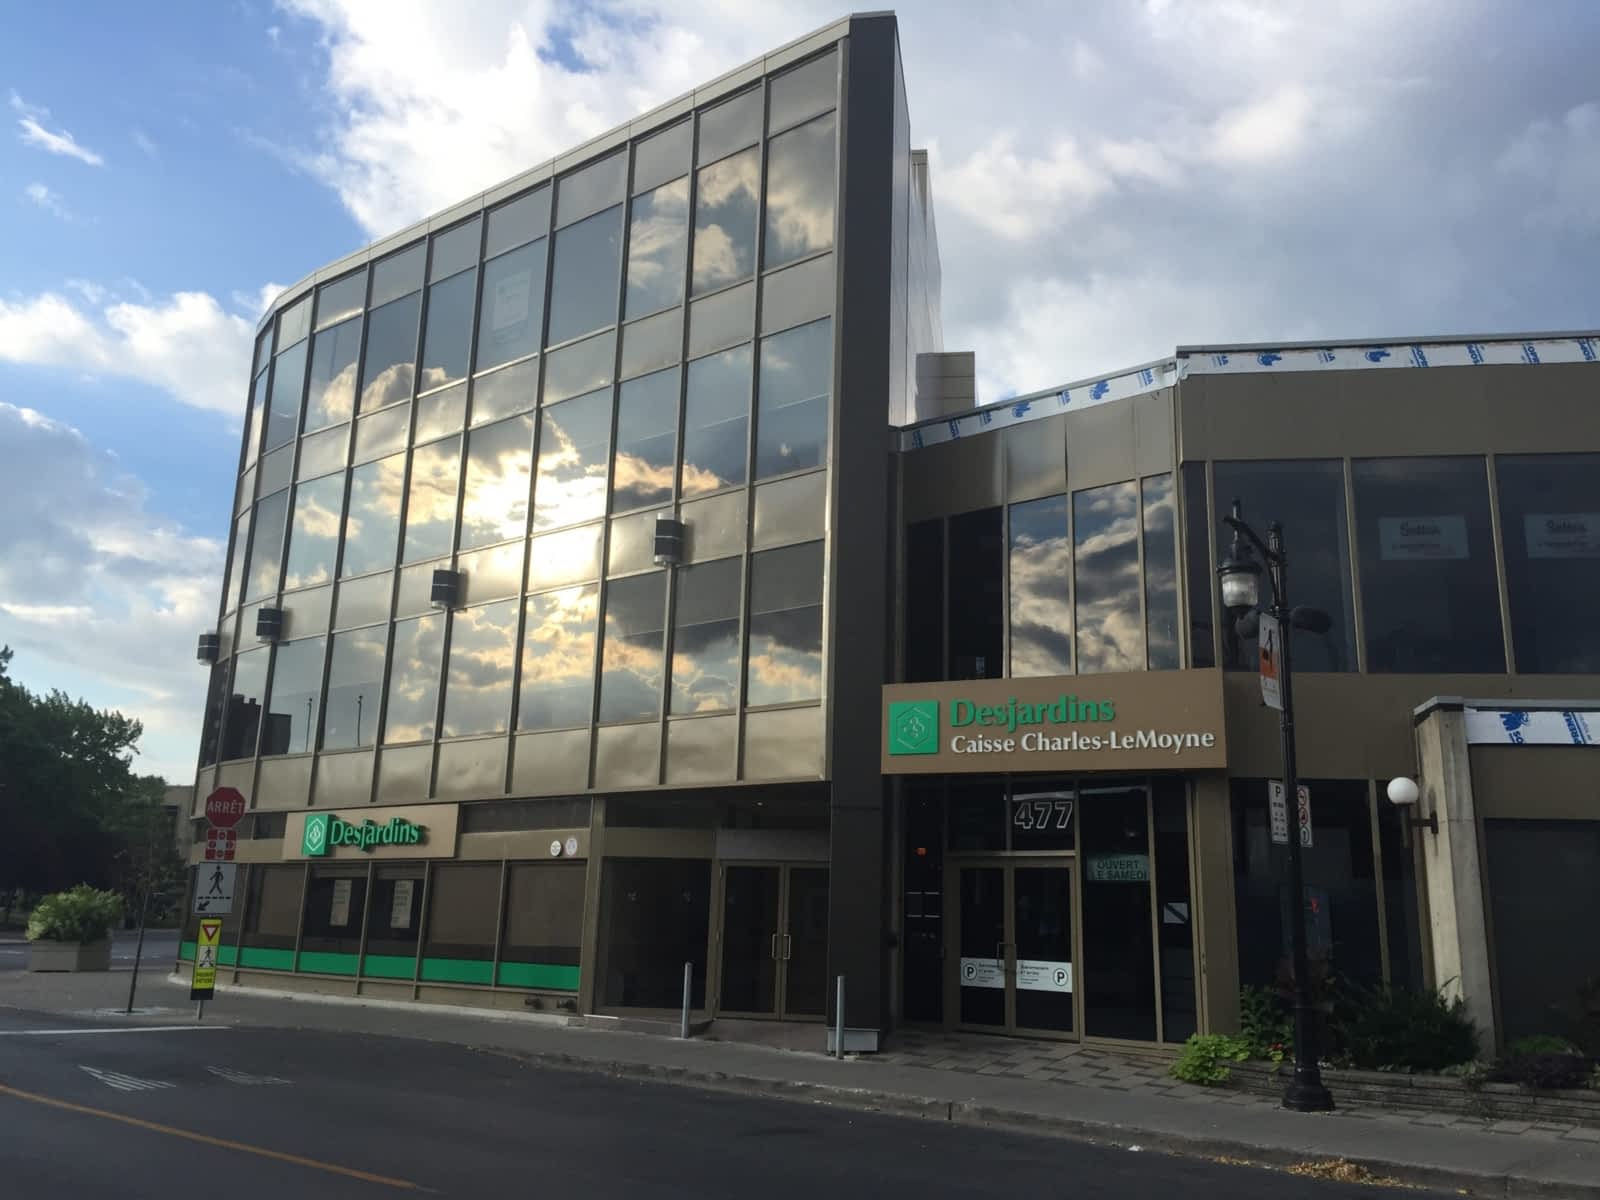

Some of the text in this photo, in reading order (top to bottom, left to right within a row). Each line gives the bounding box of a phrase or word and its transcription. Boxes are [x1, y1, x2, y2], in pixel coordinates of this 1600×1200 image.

[951, 695, 1115, 733] Desjardins
[951, 731, 1215, 753] Caisse Charles-LeMoyne
[207, 800, 243, 816] ARRÊT
[1014, 802, 1073, 829] 477
[330, 817, 419, 851] Desjardins
[1096, 860, 1139, 870] OUVERT
[1107, 870, 1147, 880] SAMEDI
[1057, 971, 1065, 983] P
